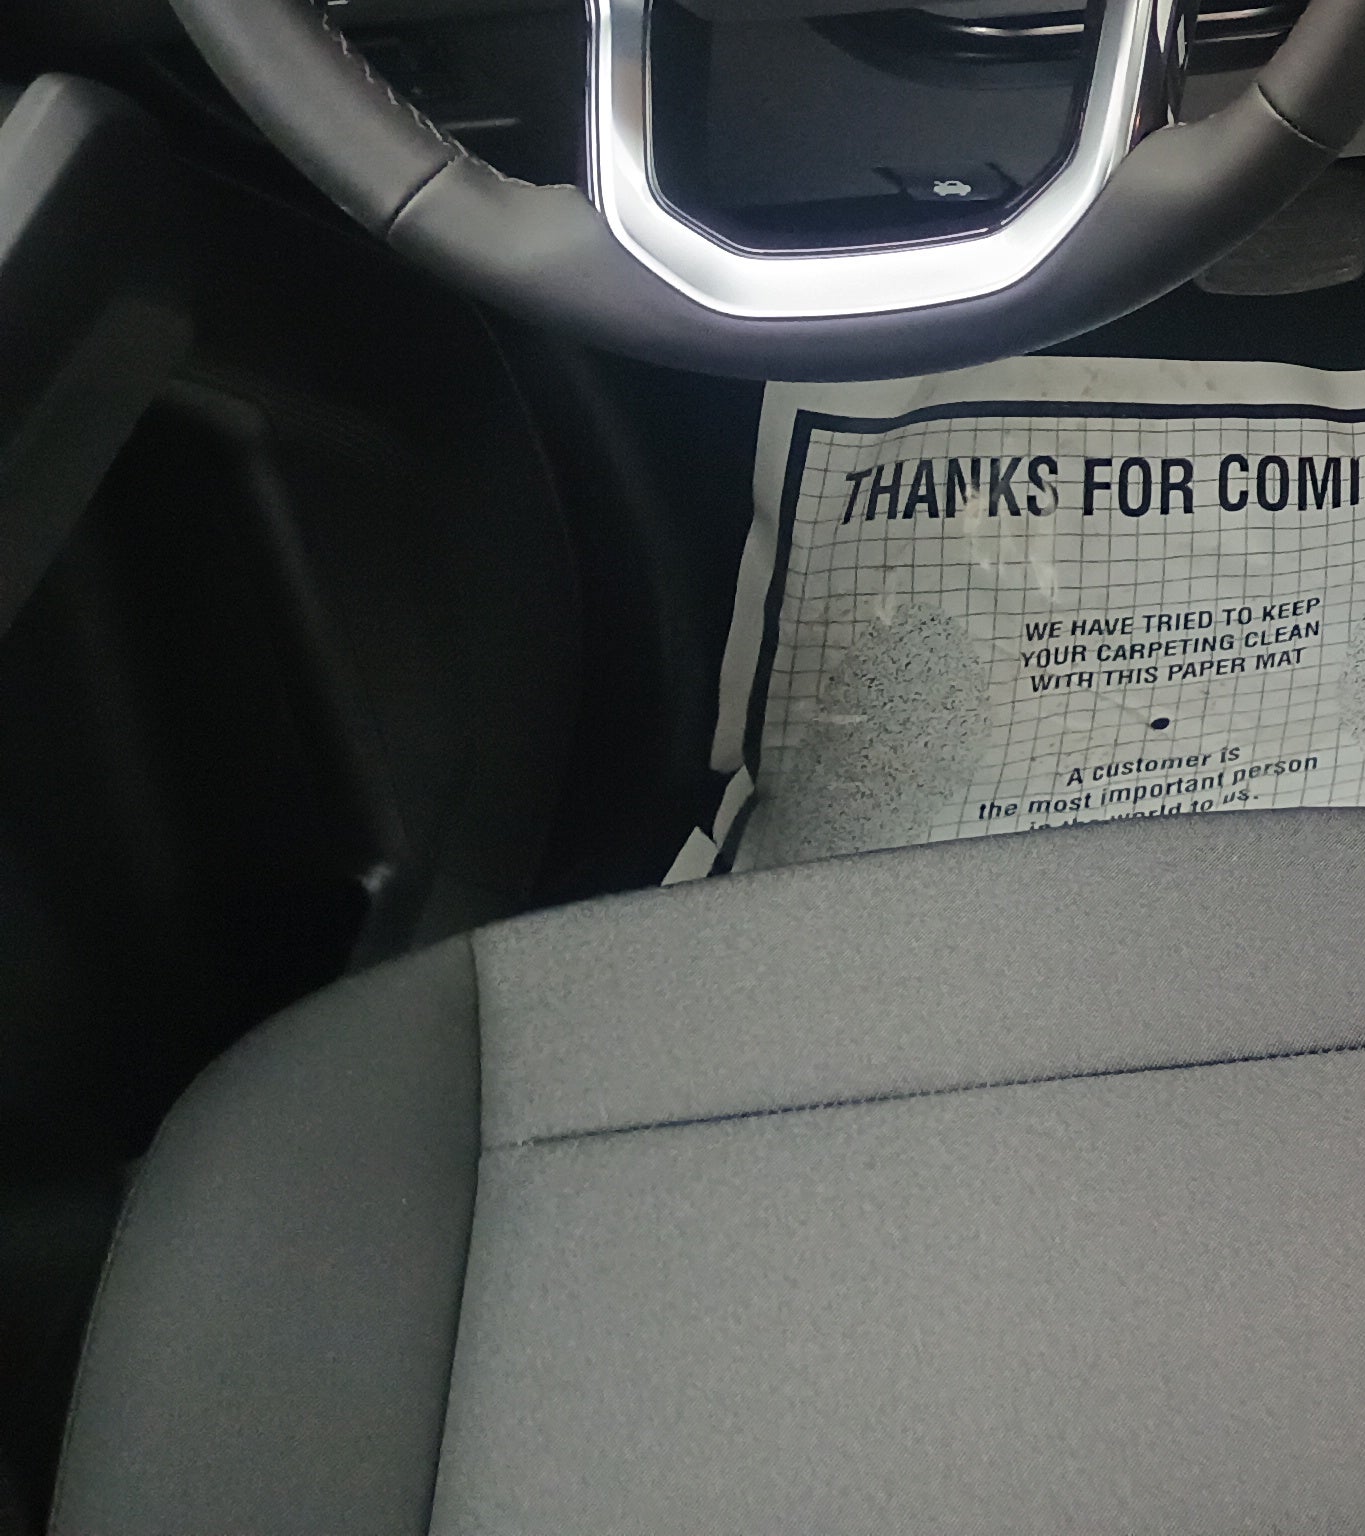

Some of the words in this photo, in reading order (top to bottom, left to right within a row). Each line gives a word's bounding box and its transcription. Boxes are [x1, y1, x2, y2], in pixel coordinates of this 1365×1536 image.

[840, 453, 1060, 527] THANKS
[1082, 455, 1196, 519] FOR
[1025, 619, 1063, 642] WE
[1070, 614, 1136, 640] HAVE
[1142, 606, 1213, 633] TRIED
[1223, 604, 1255, 627] TO
[1260, 596, 1322, 622] KEEP
[1020, 642, 1088, 669] YOUR
[1095, 632, 1235, 665] CARPETING
[1243, 619, 1321, 650] CLEAN
[1030, 668, 1096, 694] WITH
[1102, 663, 1159, 689] THIS
[1167, 654, 1247, 684] PAPER
[1255, 646, 1306, 672] MAT
[978, 802, 1019, 821] the
[1028, 792, 1091, 815] most
[1100, 771, 1225, 807] important
[1231, 754, 1319, 787] person
[1066, 767, 1084, 787] A
[1092, 752, 1213, 783] customer
[1219, 745, 1241, 762] is
[1190, 798, 1214, 814] to
[1222, 787, 1260, 805] us.
